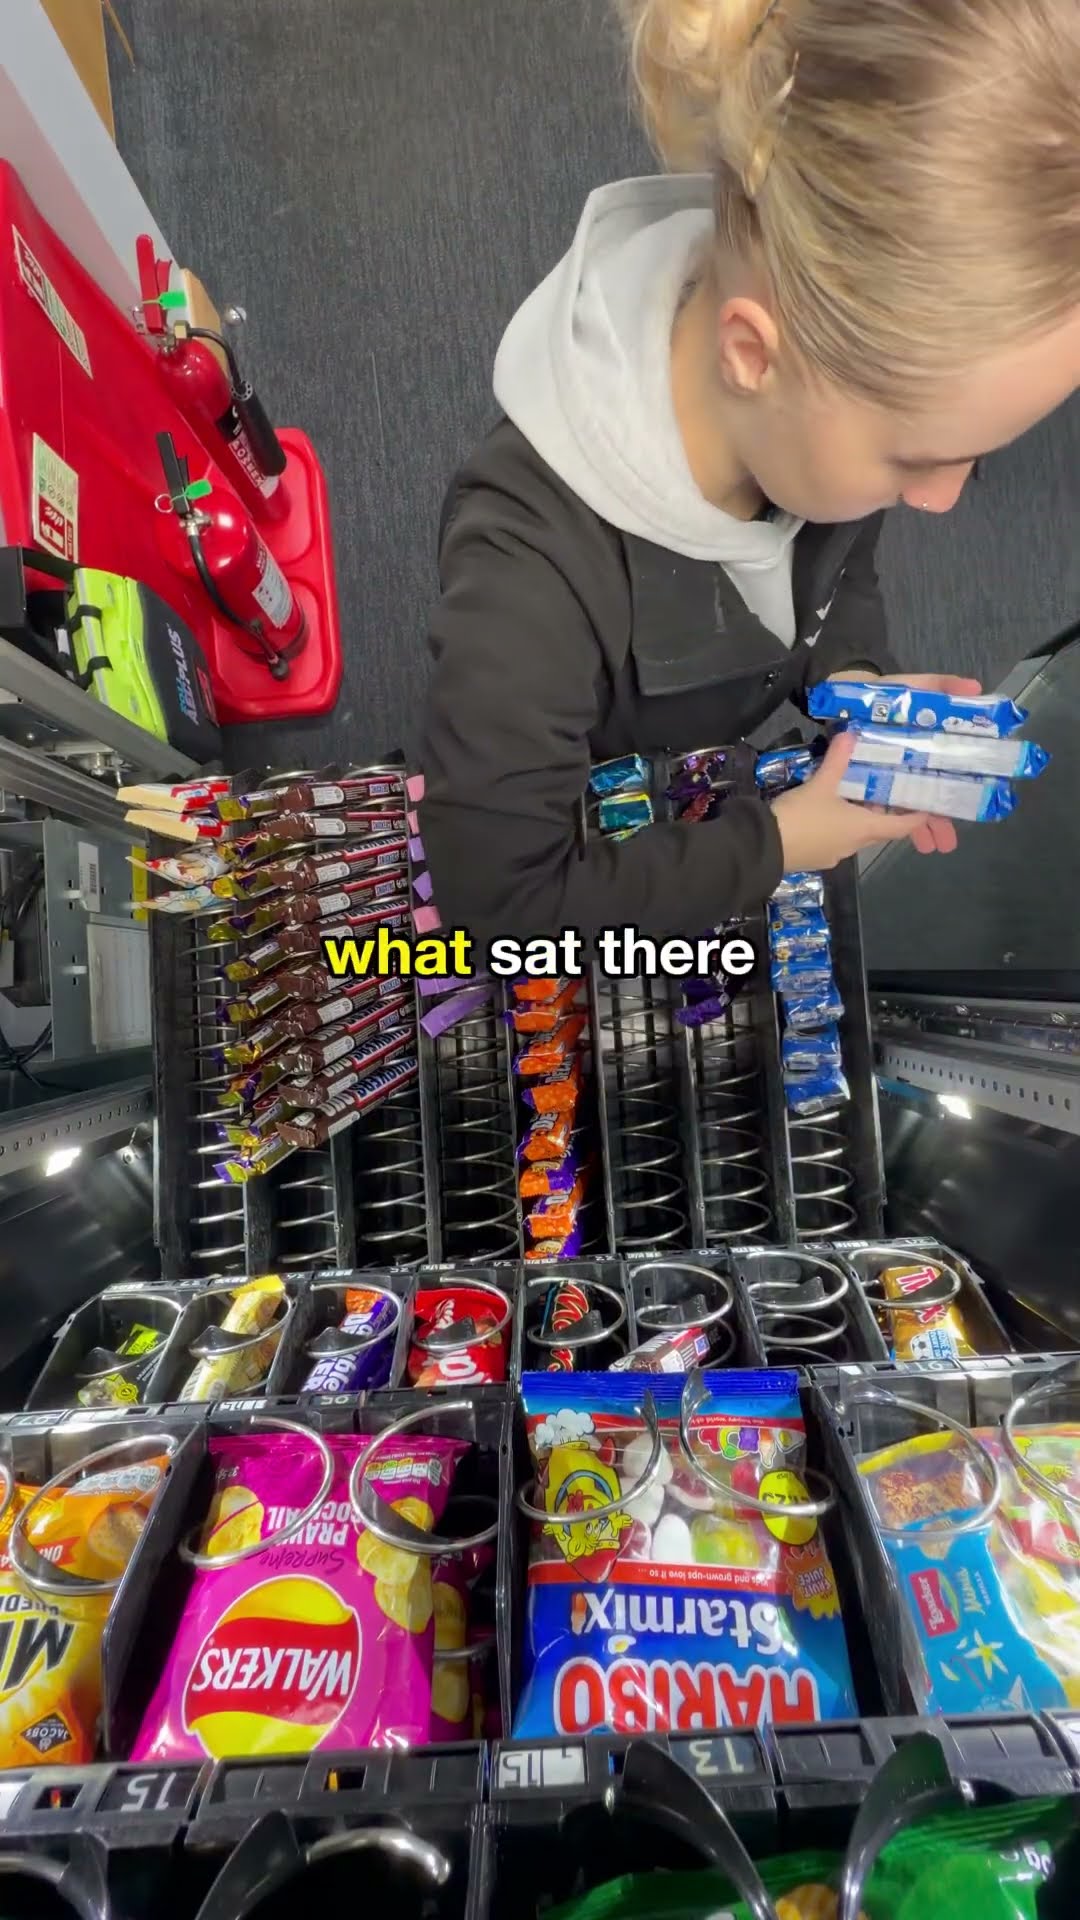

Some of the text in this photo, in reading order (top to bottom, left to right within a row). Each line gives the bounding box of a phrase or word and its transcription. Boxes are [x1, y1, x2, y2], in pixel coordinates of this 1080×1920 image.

[660, 1569, 667, 1580] it
[668, 1570, 686, 1581] love
[688, 1569, 732, 1583] grown-ups
[734, 1573, 750, 1583] and
[798, 1567, 826, 1584] JUICE
[802, 1579, 832, 1598] FRUIT
[585, 1591, 782, 1655] Starmix
[192, 1647, 353, 1700] WALKERS
[553, 1656, 821, 1734] HARIBO
[688, 1739, 743, 1775] 13
[120, 1772, 176, 1813] 15
